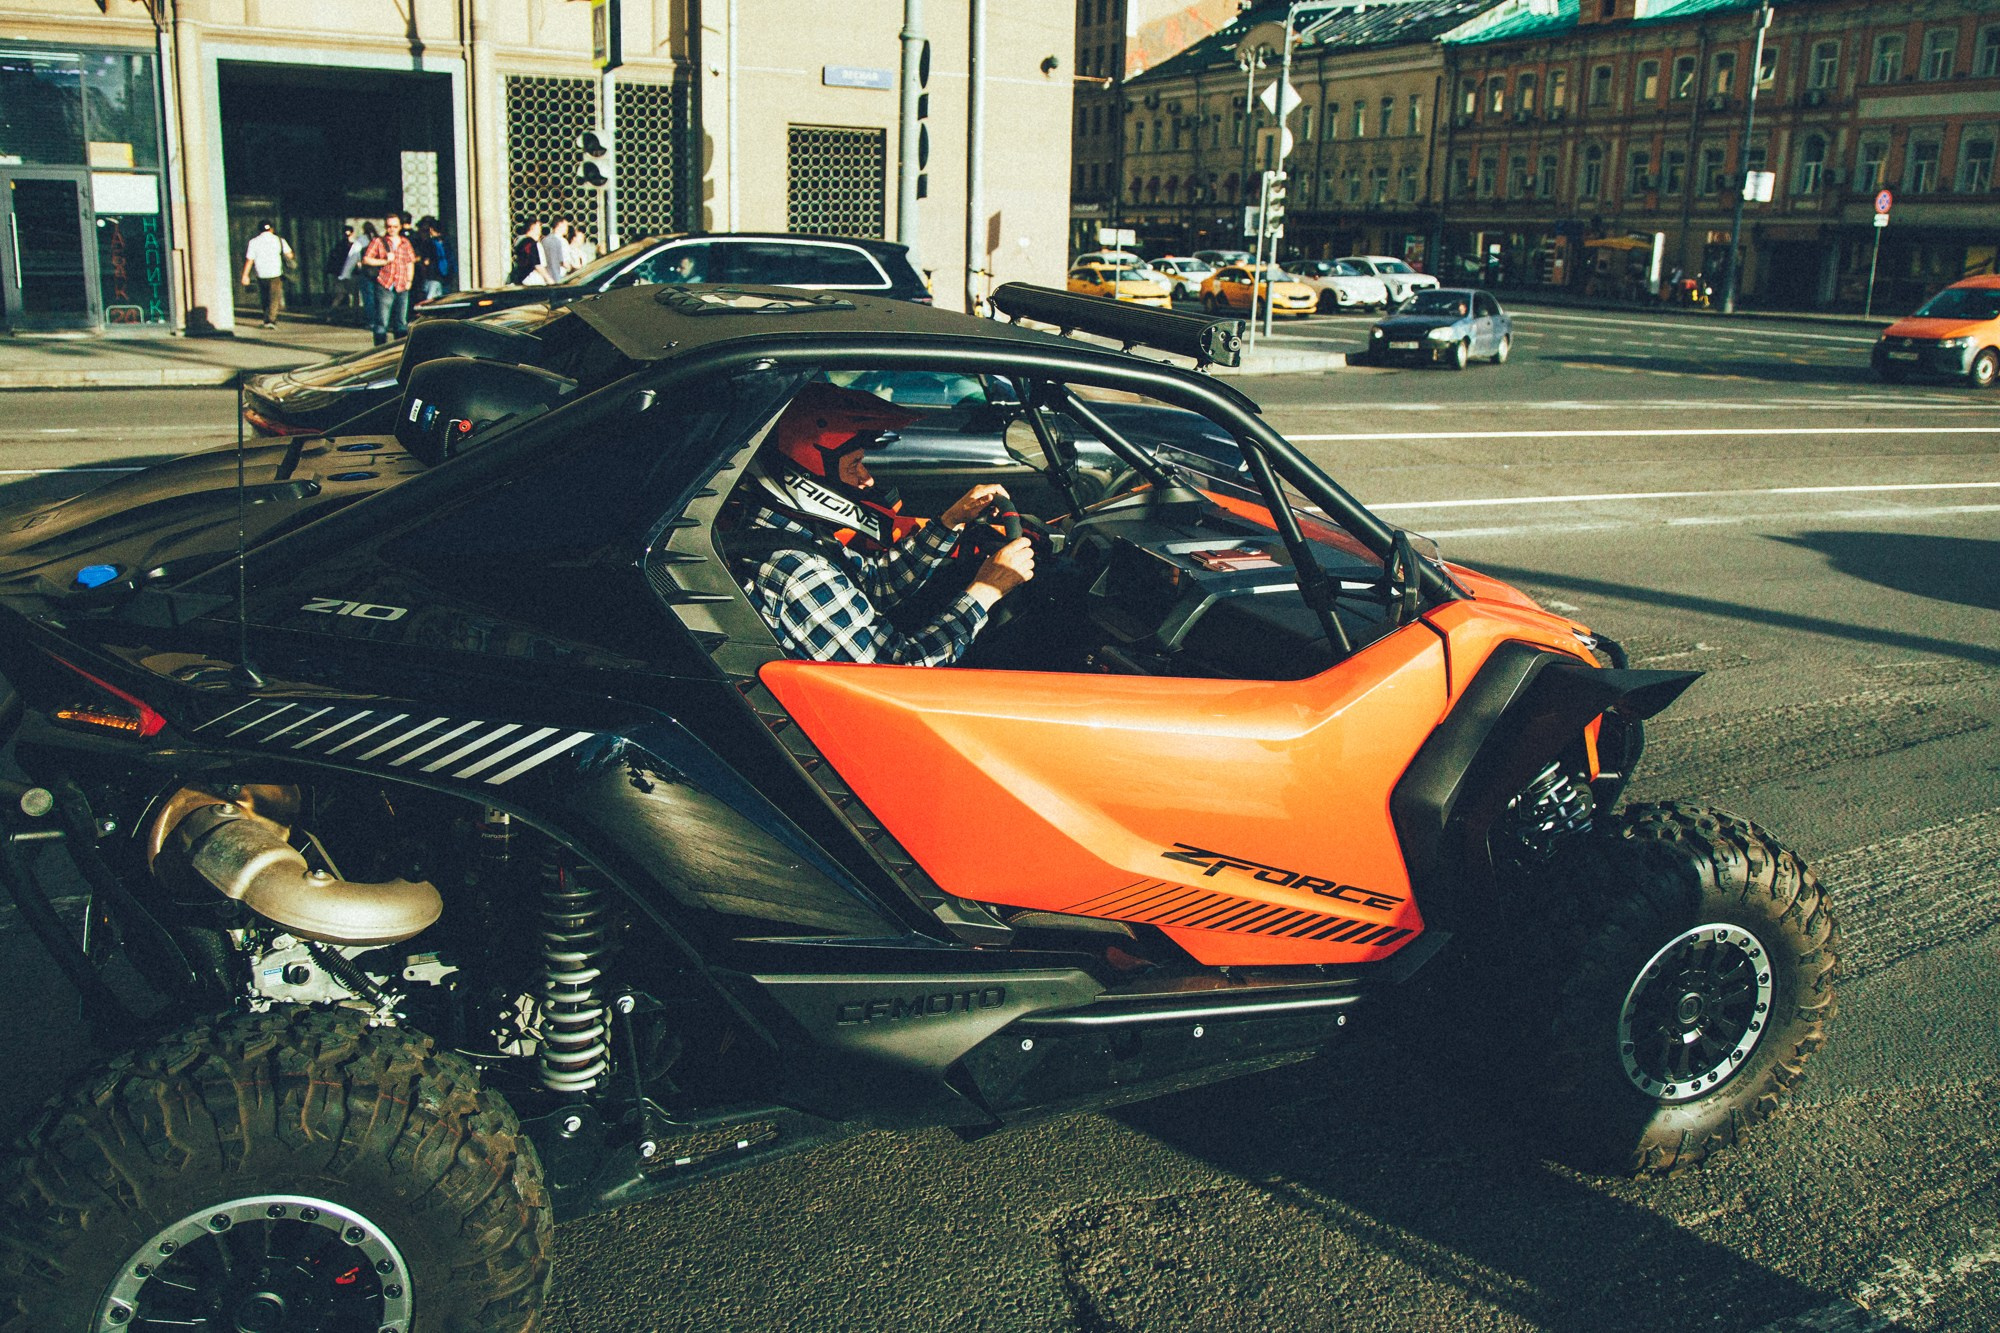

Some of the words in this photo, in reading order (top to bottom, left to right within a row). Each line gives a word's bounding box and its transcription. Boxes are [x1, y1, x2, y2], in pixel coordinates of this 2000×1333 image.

[300, 597, 408, 621] Z10
[1160, 842, 1406, 911] ZFORCE
[835, 986, 1006, 1026] CFMOTO
